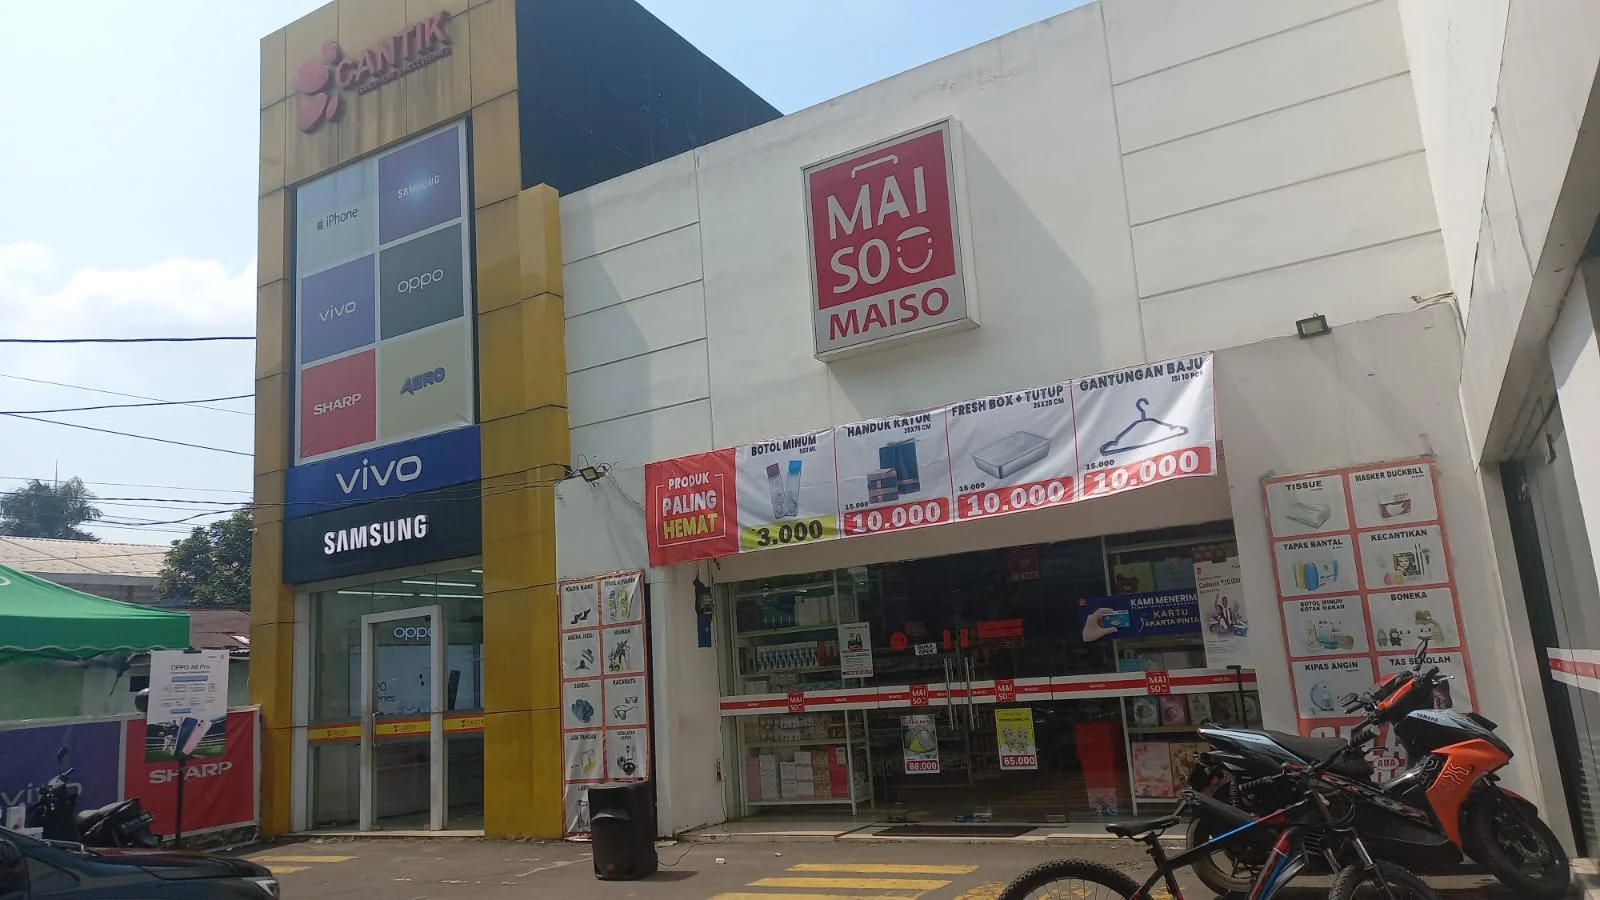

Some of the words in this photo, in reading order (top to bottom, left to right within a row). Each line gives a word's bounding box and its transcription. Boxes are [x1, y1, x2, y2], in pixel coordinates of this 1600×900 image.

[335, 10, 452, 90] CANTIK
[397, 175, 440, 199] SAMSUNG
[826, 165, 928, 241] MAI
[326, 206, 358, 228] iPhone
[397, 268, 444, 293] oppo
[319, 301, 357, 321] vivo
[829, 287, 950, 341] MAISO
[400, 366, 446, 396] AERO
[1079, 364, 1164, 391] GANTUNGAN
[1166, 357, 1203, 376] BAJU
[313, 393, 362, 415] SHARP
[951, 400, 987, 418] FRESH
[988, 393, 1013, 411] BOX
[1024, 385, 1064, 403] TUTUP
[847, 420, 891, 438] HANDUK
[751, 444, 782, 457] BOTOL
[782, 435, 817, 451] MINUM
[336, 455, 422, 494] vivo
[1086, 459, 1115, 471] 15.000
[1092, 450, 1199, 494] 10.000
[1355, 473, 1386, 482] MASKER
[1386, 466, 1424, 478] DUCKBILL
[668, 472, 710, 490] PRODUK
[959, 482, 986, 492] 15.000
[1285, 480, 1323, 491] TISSUE
[662, 489, 717, 517] PALING
[845, 500, 869, 510] 15.000
[967, 481, 1065, 517] 10.000
[663, 512, 718, 540] HEMAT
[851, 502, 941, 533] 10.000
[323, 514, 430, 556] SAMSUNG
[757, 520, 823, 547] 3.000
[1370, 529, 1428, 542] KECANTIKAN
[1283, 543, 1309, 551] TAPAS
[1310, 538, 1344, 548] BANTAL
[1130, 598, 1155, 607] KAMI
[1155, 592, 1197, 605] MENERIM
[1321, 598, 1344, 606] MINUM
[1390, 591, 1428, 601] BONEKA
[1153, 608, 1188, 618] KARTU
[1138, 617, 1176, 632] JAKARTA
[1177, 616, 1200, 624] PINTA
[1331, 661, 1359, 670] ANGIN
[1390, 658, 1407, 666] TAS
[1408, 656, 1451, 666] SEKOLAH
[997, 684, 1012, 693] MAI
[1149, 675, 1167, 684] MAI
[912, 689, 926, 697] MAI
[909, 761, 937, 770] 88.000
[1004, 756, 1035, 766] 65.000
[150, 761, 233, 784] SHARP
